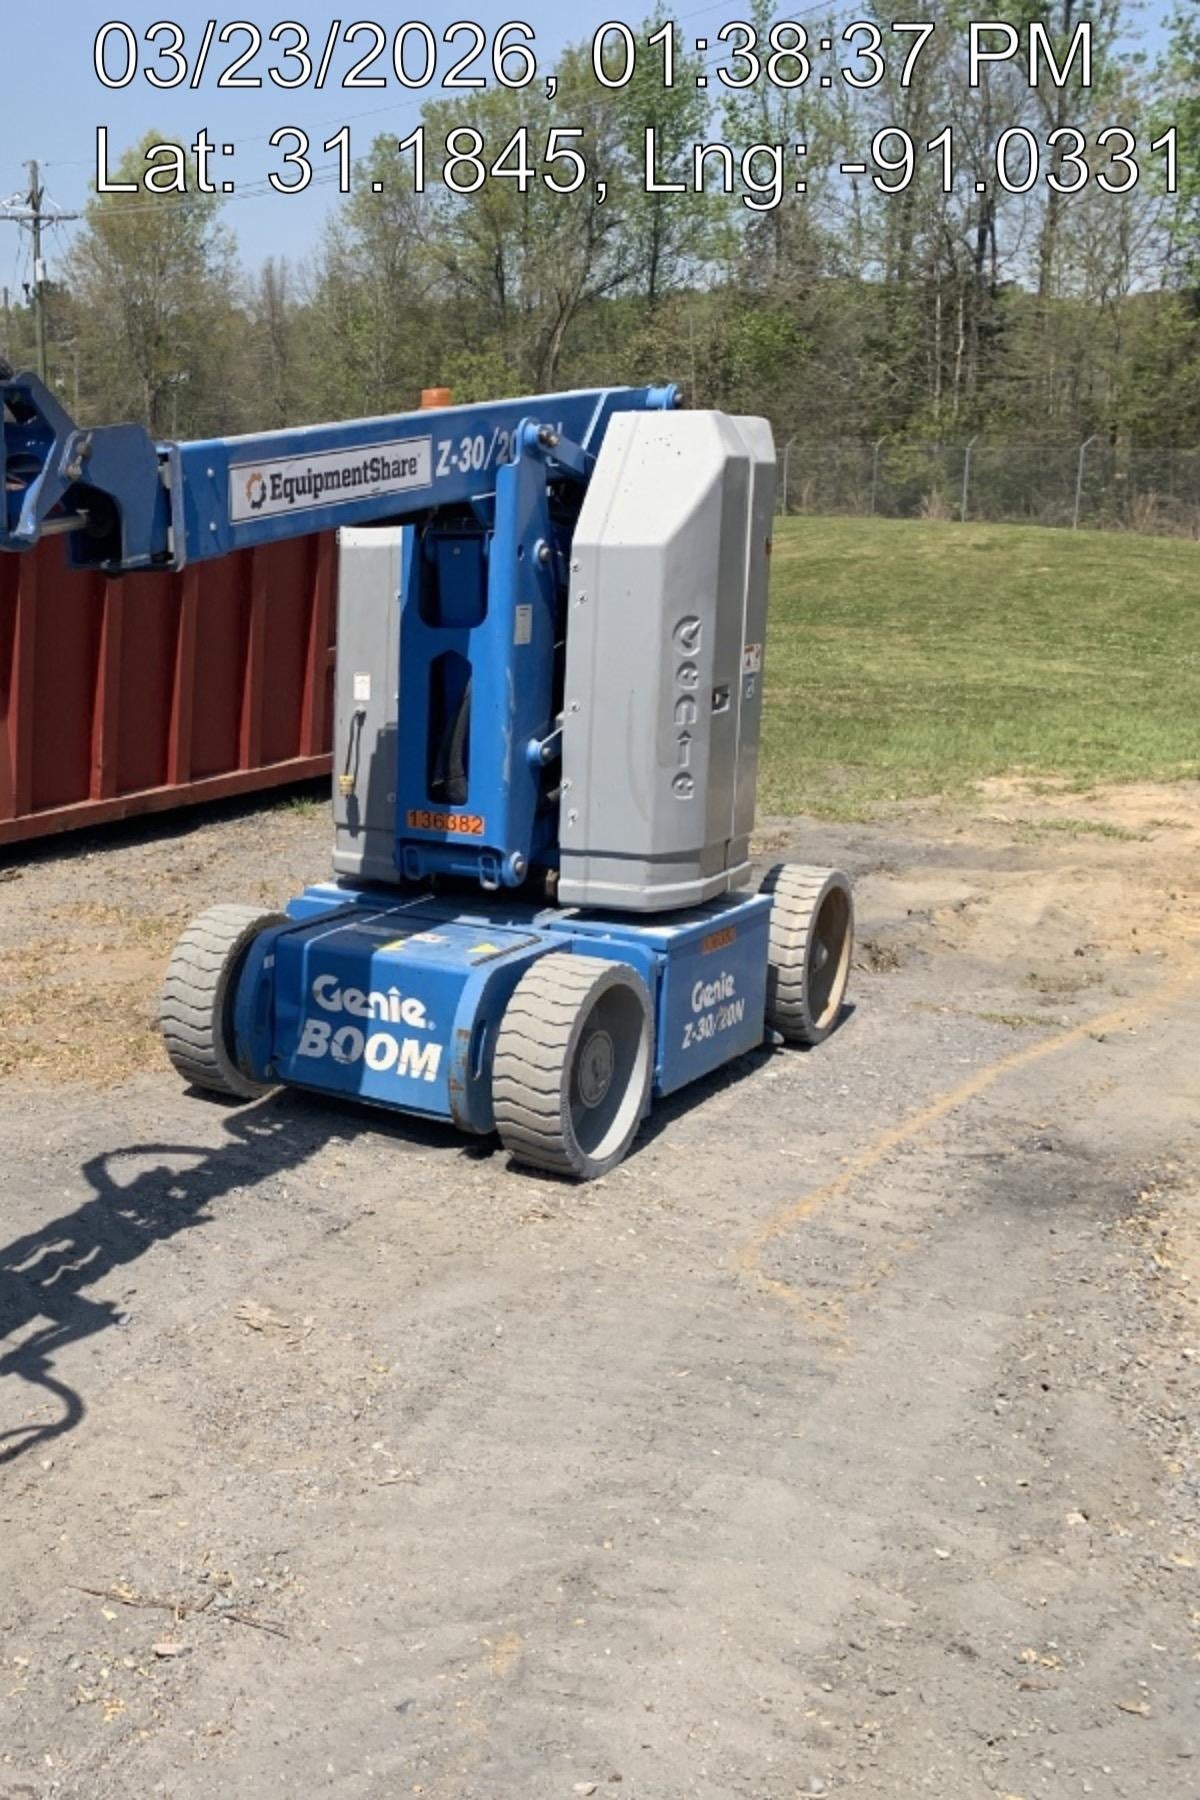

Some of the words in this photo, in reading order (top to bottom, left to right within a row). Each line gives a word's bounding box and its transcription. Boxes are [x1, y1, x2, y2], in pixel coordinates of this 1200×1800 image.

[269, 455, 418, 502] EquipmentShare
[312, 974, 428, 1030] Genie
[691, 971, 736, 1013] Genie
[297, 1018, 443, 1083] BOOM
